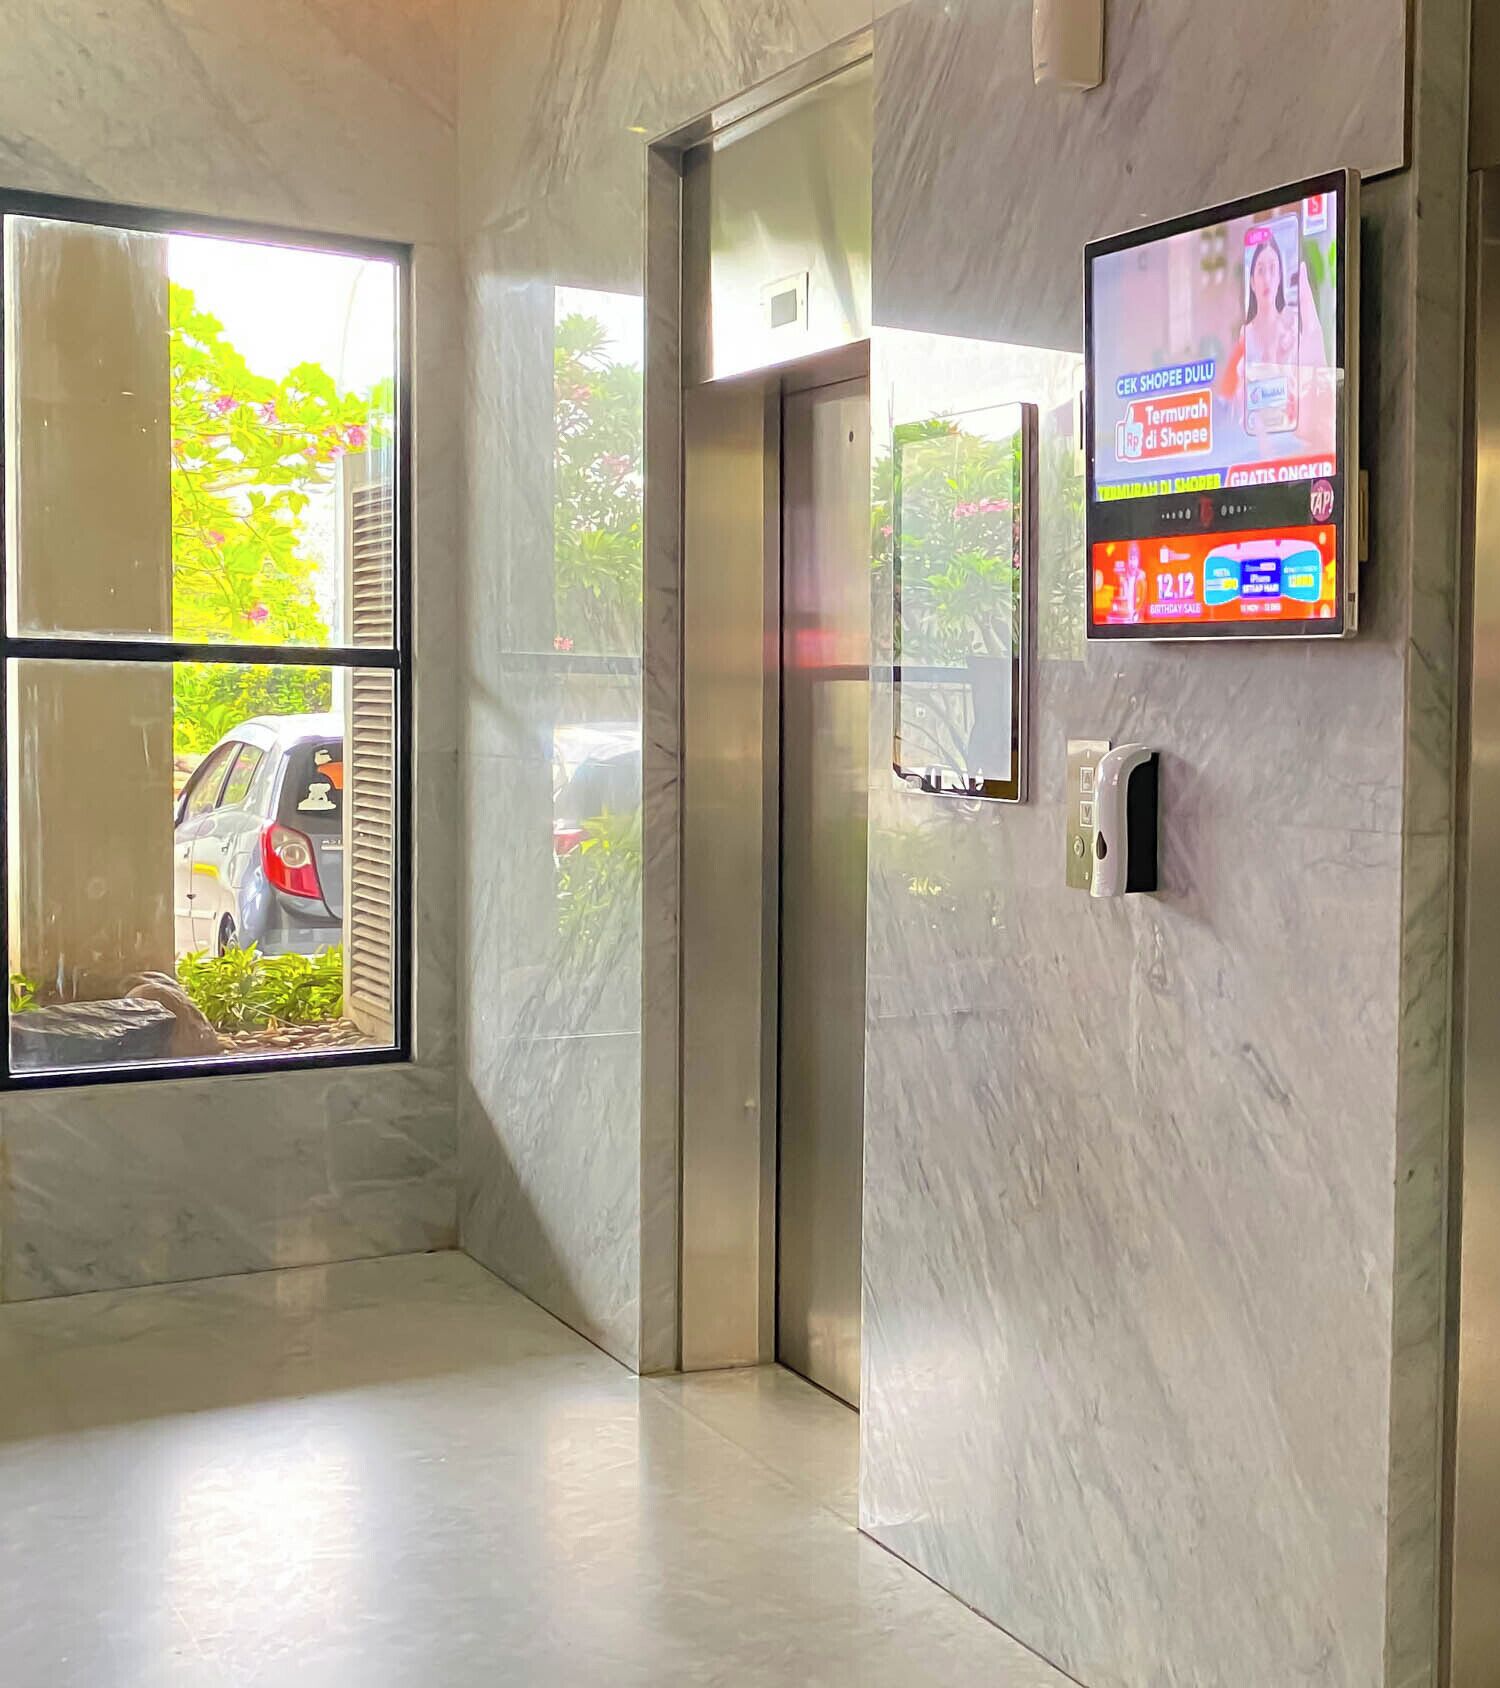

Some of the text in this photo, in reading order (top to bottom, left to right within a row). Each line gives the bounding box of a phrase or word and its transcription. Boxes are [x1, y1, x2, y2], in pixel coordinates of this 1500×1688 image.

[1117, 362, 1214, 395] CEK SHOPEE DULU
[1145, 398, 1208, 426] Termurah
[1145, 427, 1208, 451] di Shopee
[1230, 468, 1276, 488] GRATIS
[1157, 571, 1195, 600] 12.12
